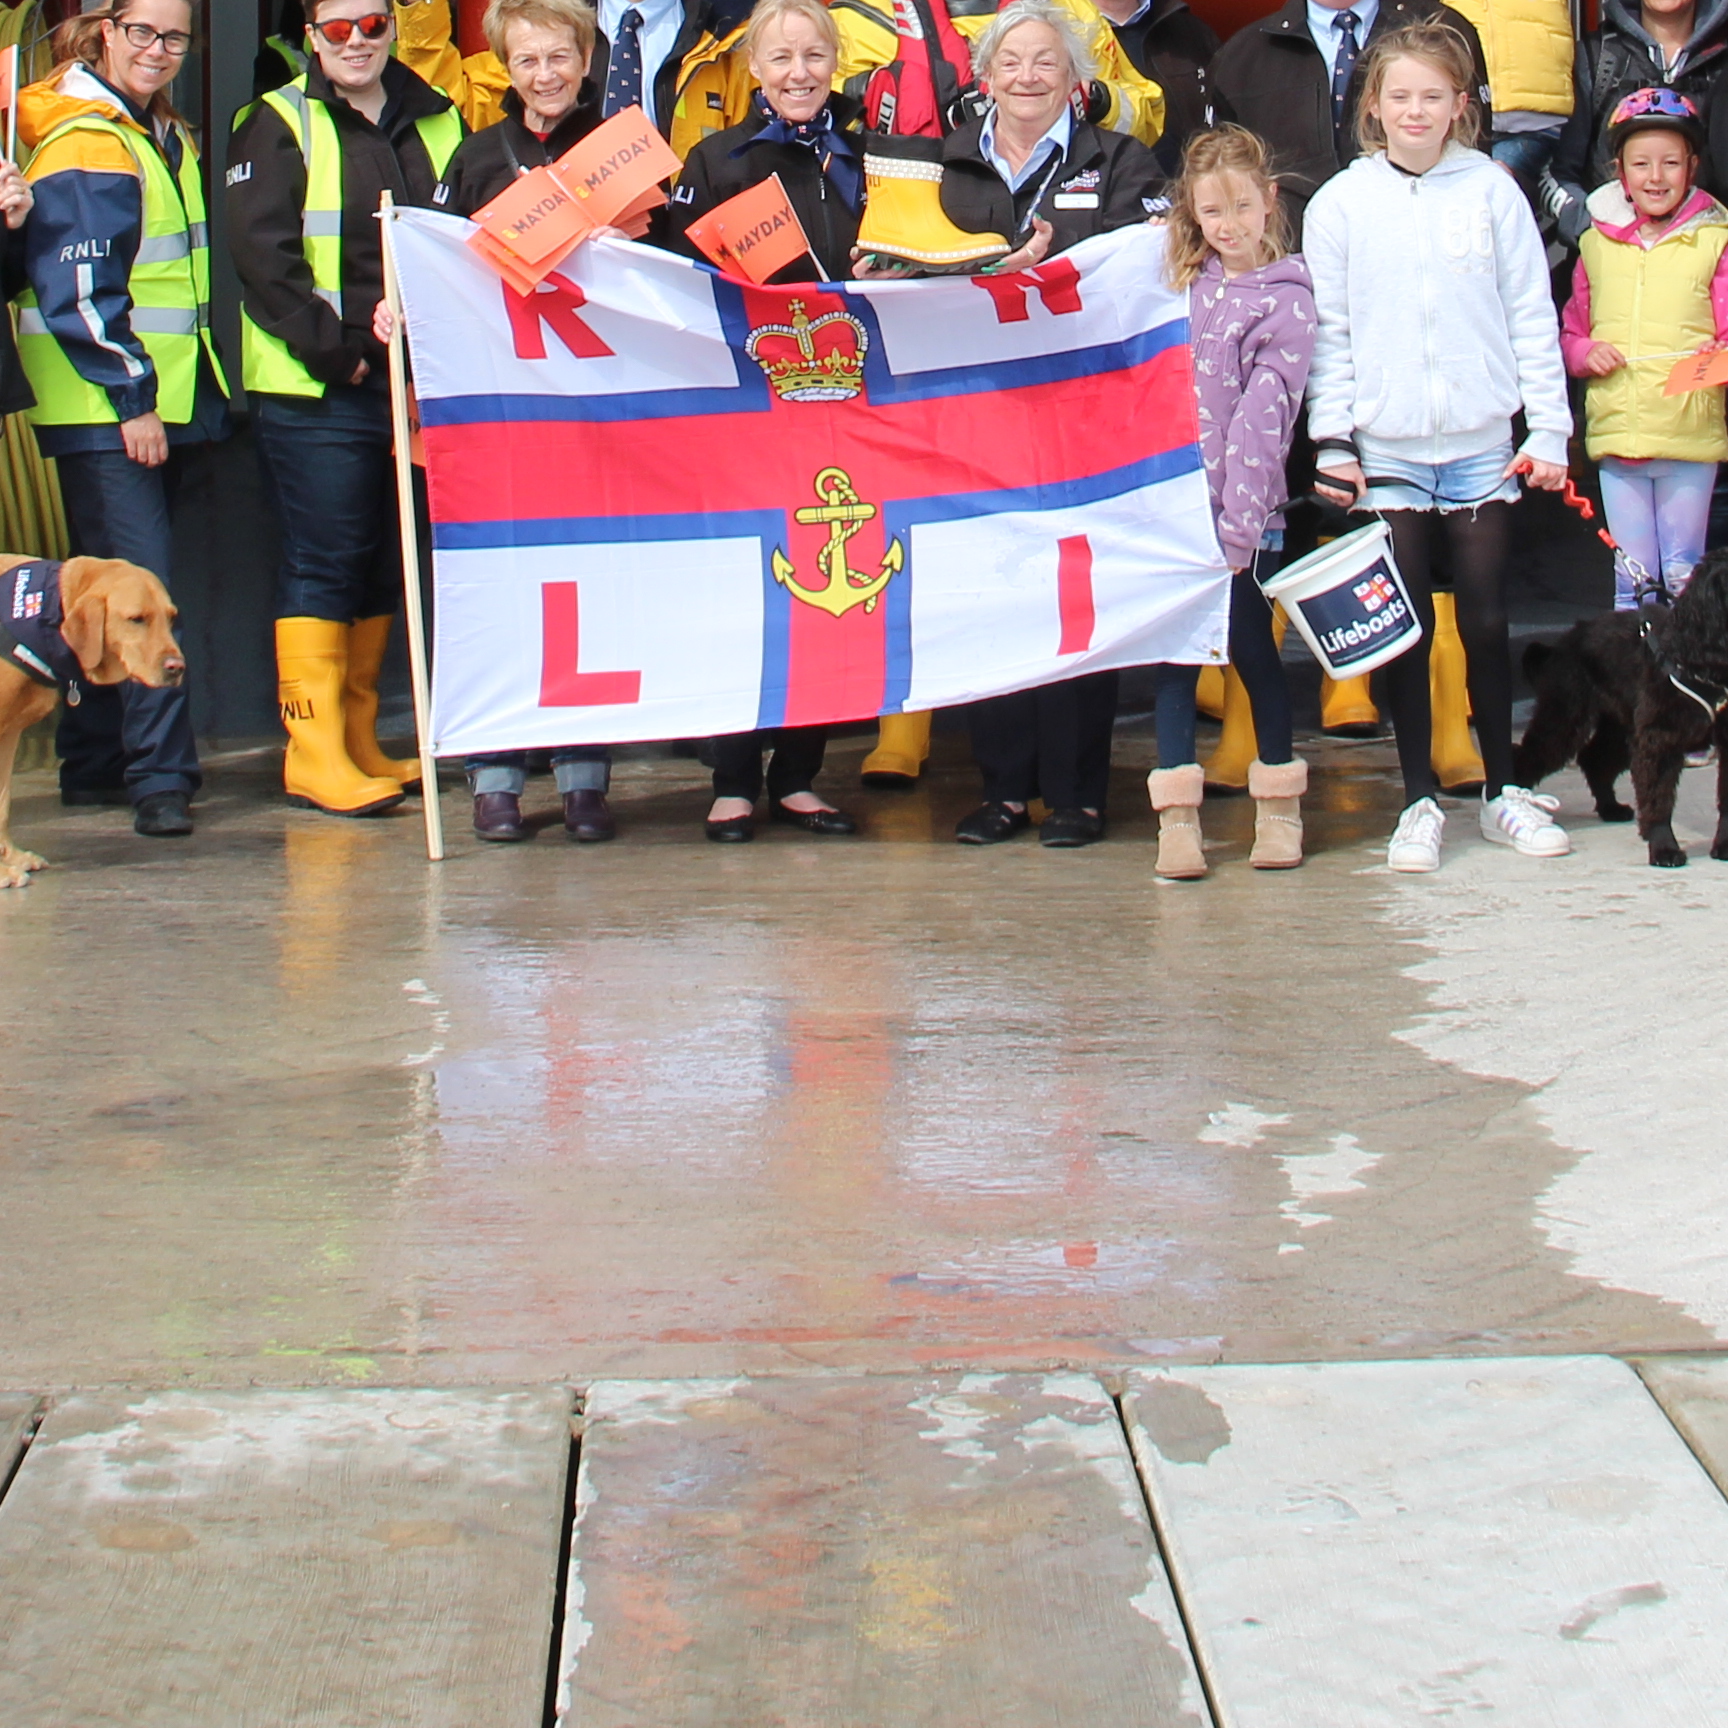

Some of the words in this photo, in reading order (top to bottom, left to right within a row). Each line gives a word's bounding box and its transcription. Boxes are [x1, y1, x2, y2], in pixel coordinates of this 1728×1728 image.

[584, 134, 653, 192] MAYDAY
[59, 238, 111, 264] RNLI
[735, 204, 791, 255] MAYDAY
[13, 568, 32, 620] Lifeboats
[539, 579, 641, 708] L
[1057, 533, 1095, 656] I
[1319, 598, 1407, 654] Lifeboats
[279, 698, 315, 722] NLI
